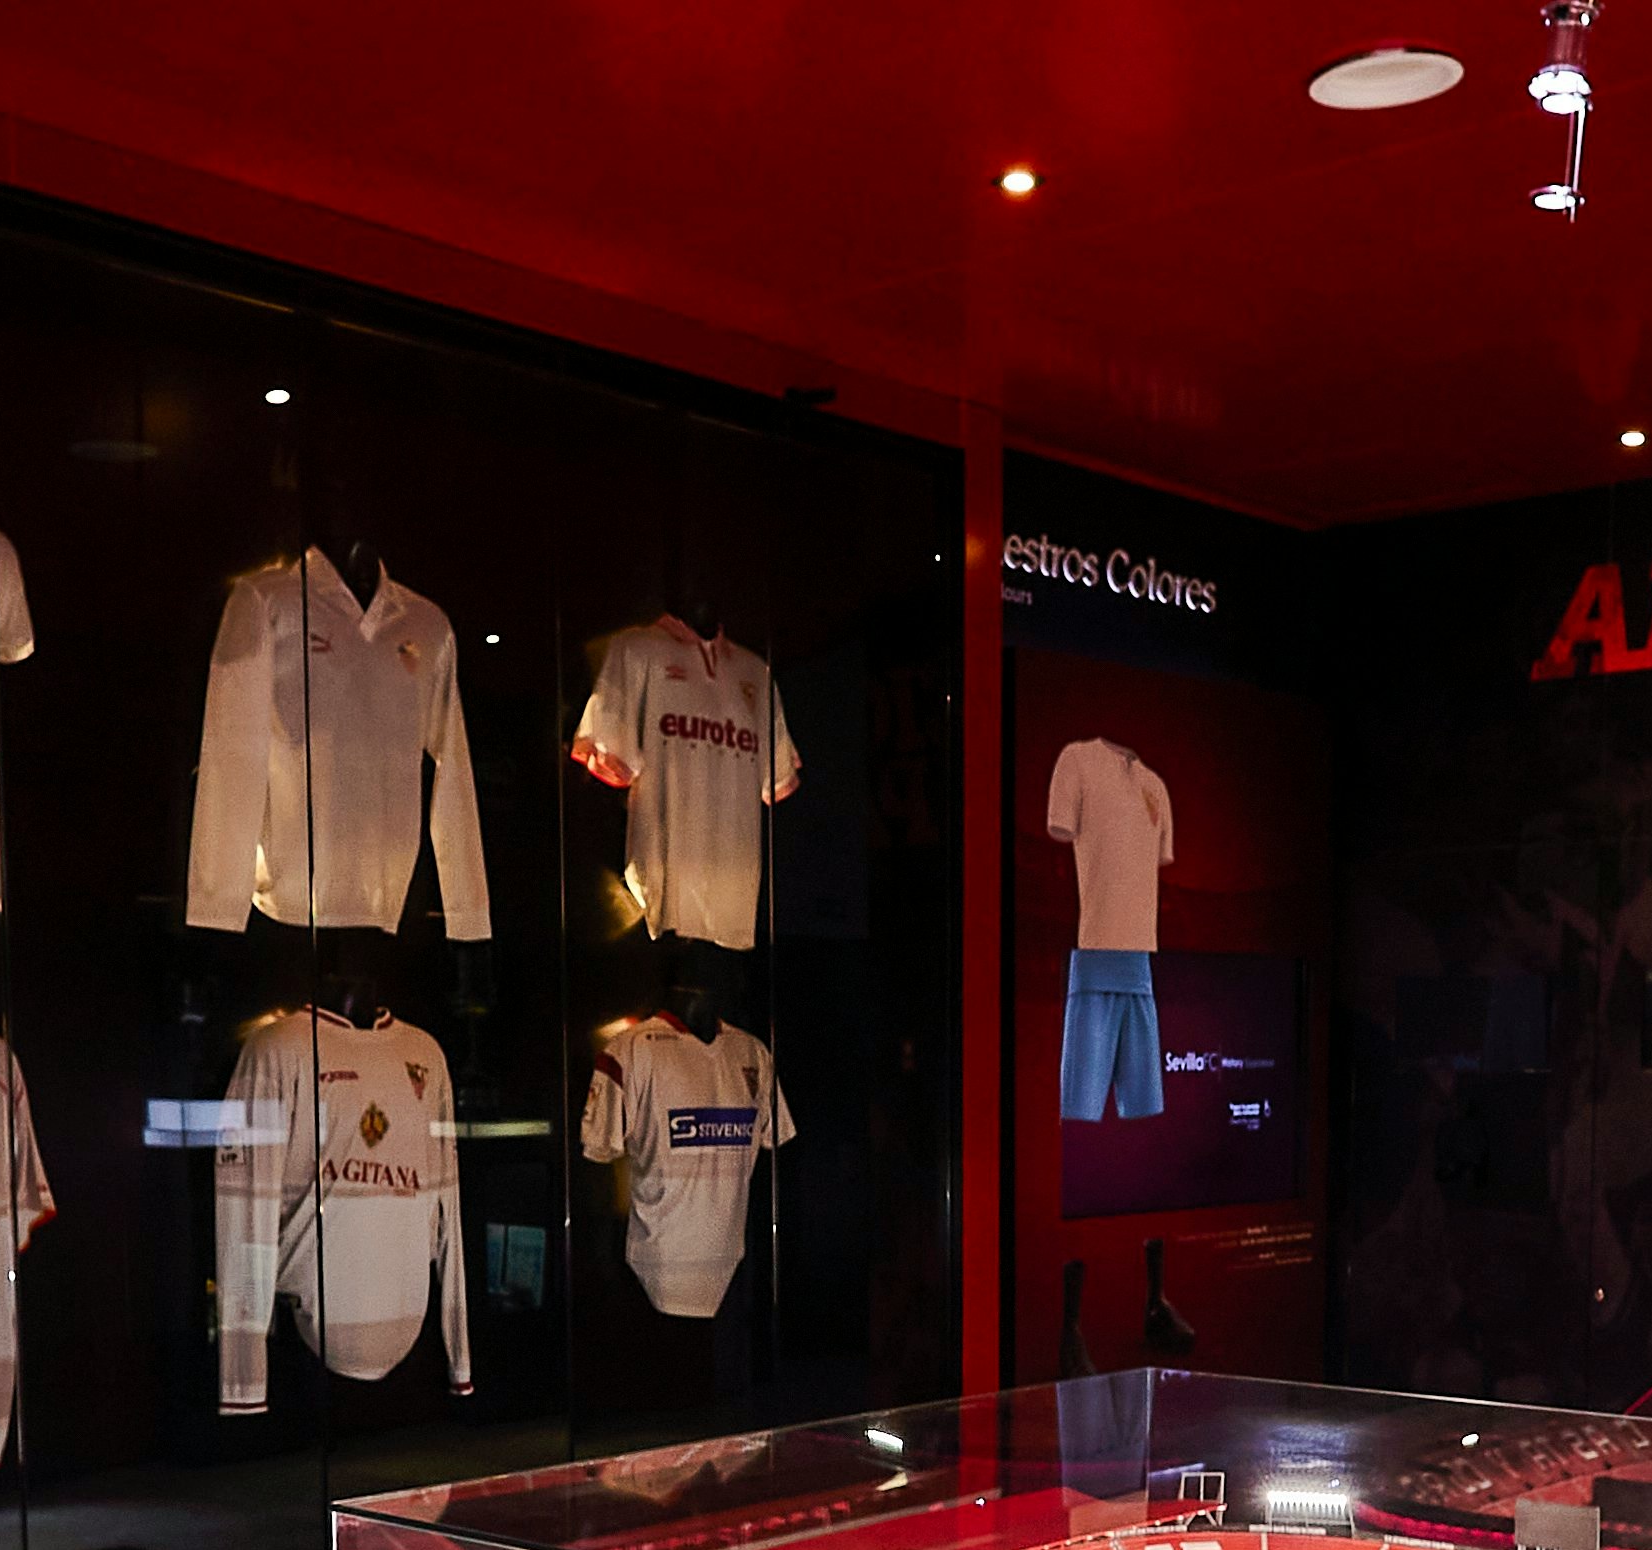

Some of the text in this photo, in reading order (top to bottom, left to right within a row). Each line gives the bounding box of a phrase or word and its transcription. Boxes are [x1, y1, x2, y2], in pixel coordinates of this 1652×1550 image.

[1003, 534, 1217, 614] estros Colores
[342, 1158, 420, 1191] GITANA
